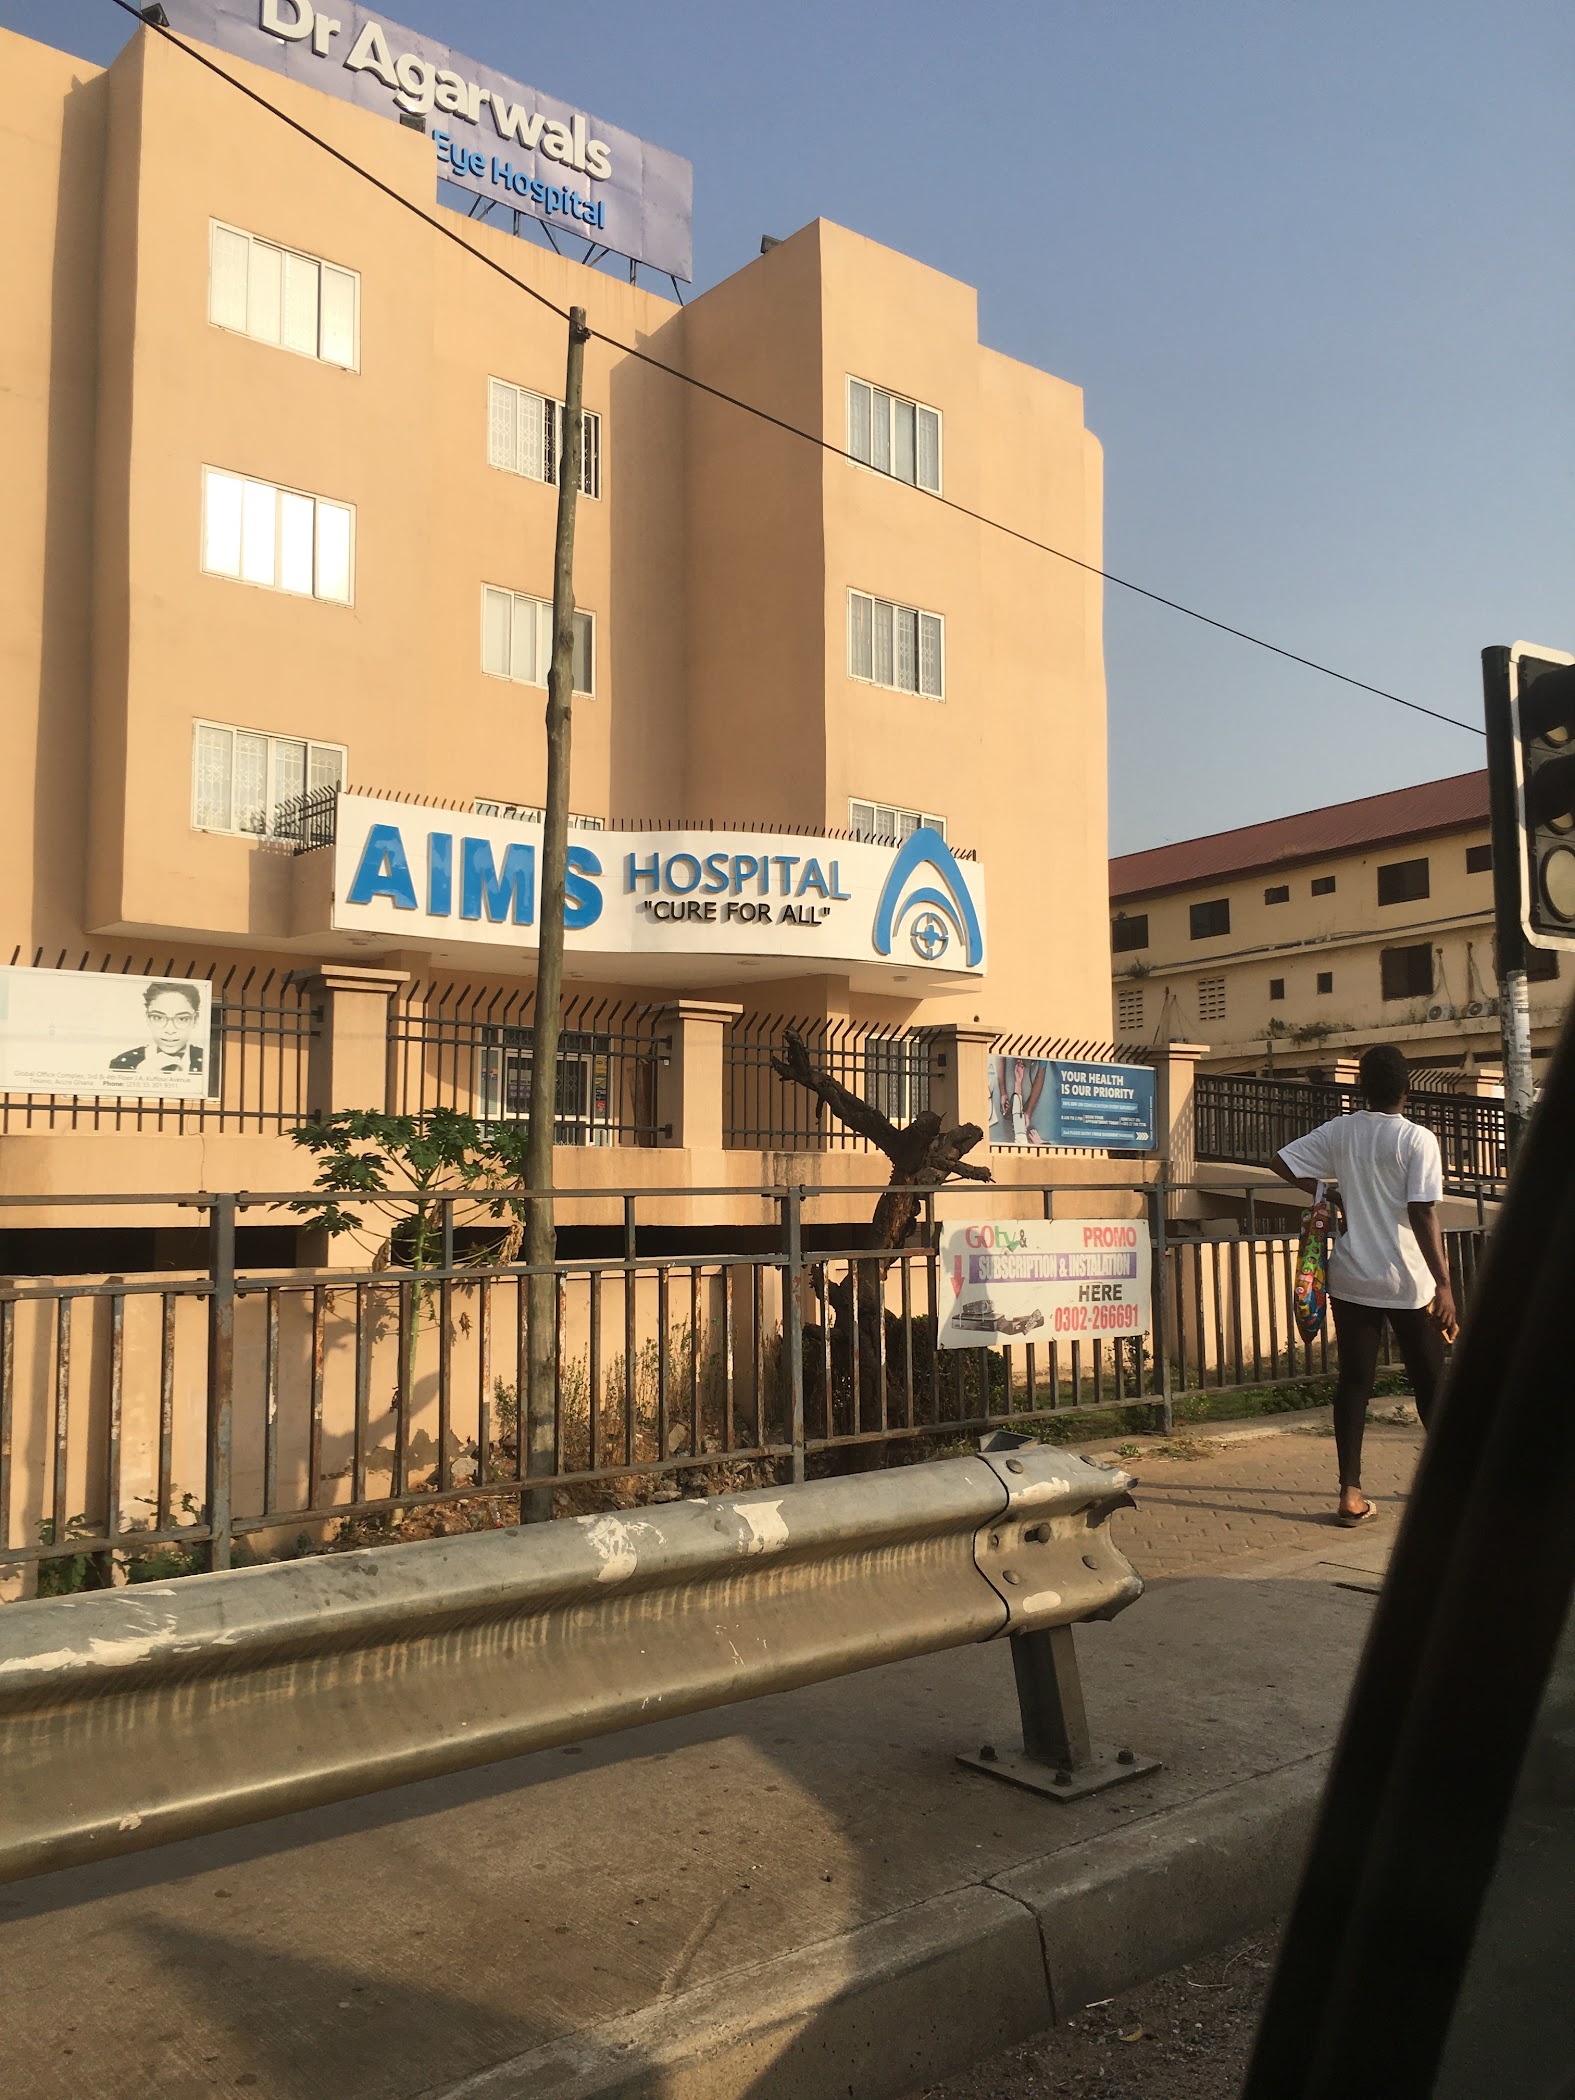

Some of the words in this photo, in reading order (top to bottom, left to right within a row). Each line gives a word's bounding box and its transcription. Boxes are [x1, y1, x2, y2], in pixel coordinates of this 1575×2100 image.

[259, 0, 342, 58] Dr
[343, 20, 613, 182] Agarwals
[431, 130, 487, 177] Eye
[491, 156, 606, 230] Hospital
[346, 823, 603, 929] AIMS
[625, 851, 852, 900] HOSPITAL
[643, 900, 720, 921] "CURE
[726, 902, 771, 924] FOR
[780, 906, 831, 926] ALL"
[1060, 1070, 1088, 1083] YOUR
[1088, 1072, 1124, 1086] HEALTH
[1061, 1083, 1071, 1095] IS
[1071, 1084, 1092, 1097] OUR
[1093, 1086, 1134, 1100] PRIORITY
[1019, 1229, 1028, 1248] &
[1082, 1226, 1137, 1248] PROMO
[978, 1254, 1057, 1280] SUBSCRIPTION
[1059, 1257, 1067, 1277] &
[1078, 1284, 1123, 1302] HERE
[1054, 1303, 1139, 1332] 0302-266691
